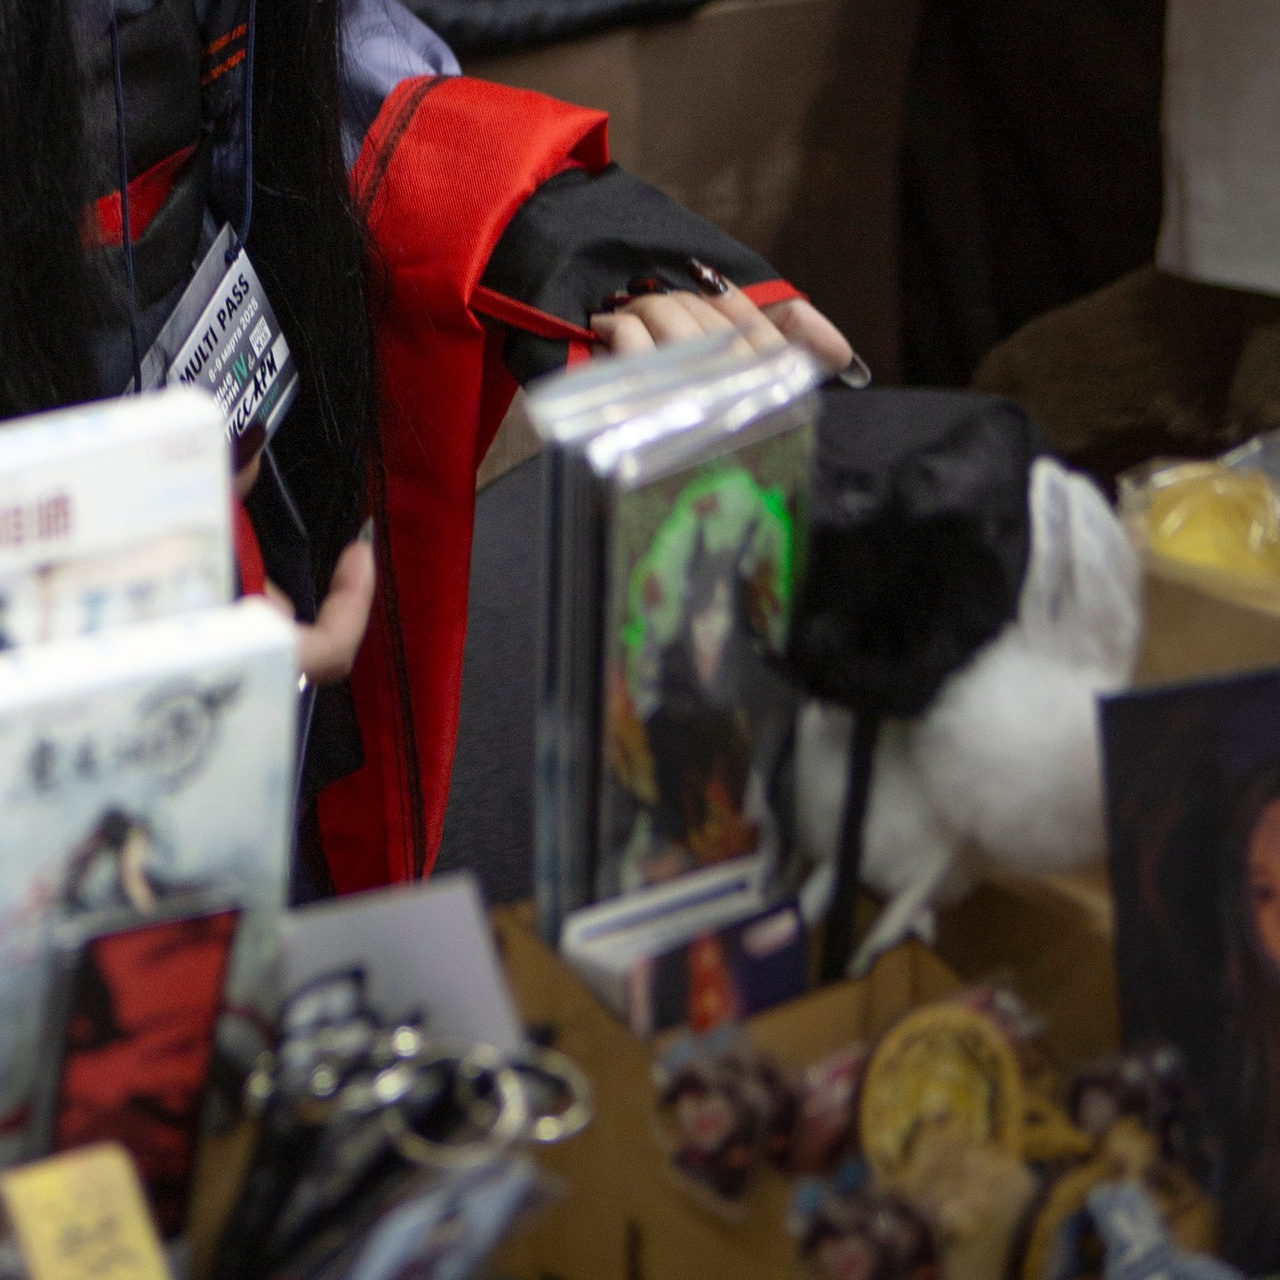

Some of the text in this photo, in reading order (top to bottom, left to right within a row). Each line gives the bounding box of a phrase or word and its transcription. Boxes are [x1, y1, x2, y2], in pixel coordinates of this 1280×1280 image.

[179, 273, 250, 386] MULTI PASS
[221, 326, 242, 364] марта
[239, 296, 259, 331] 2025
[231, 352, 248, 388] IV
